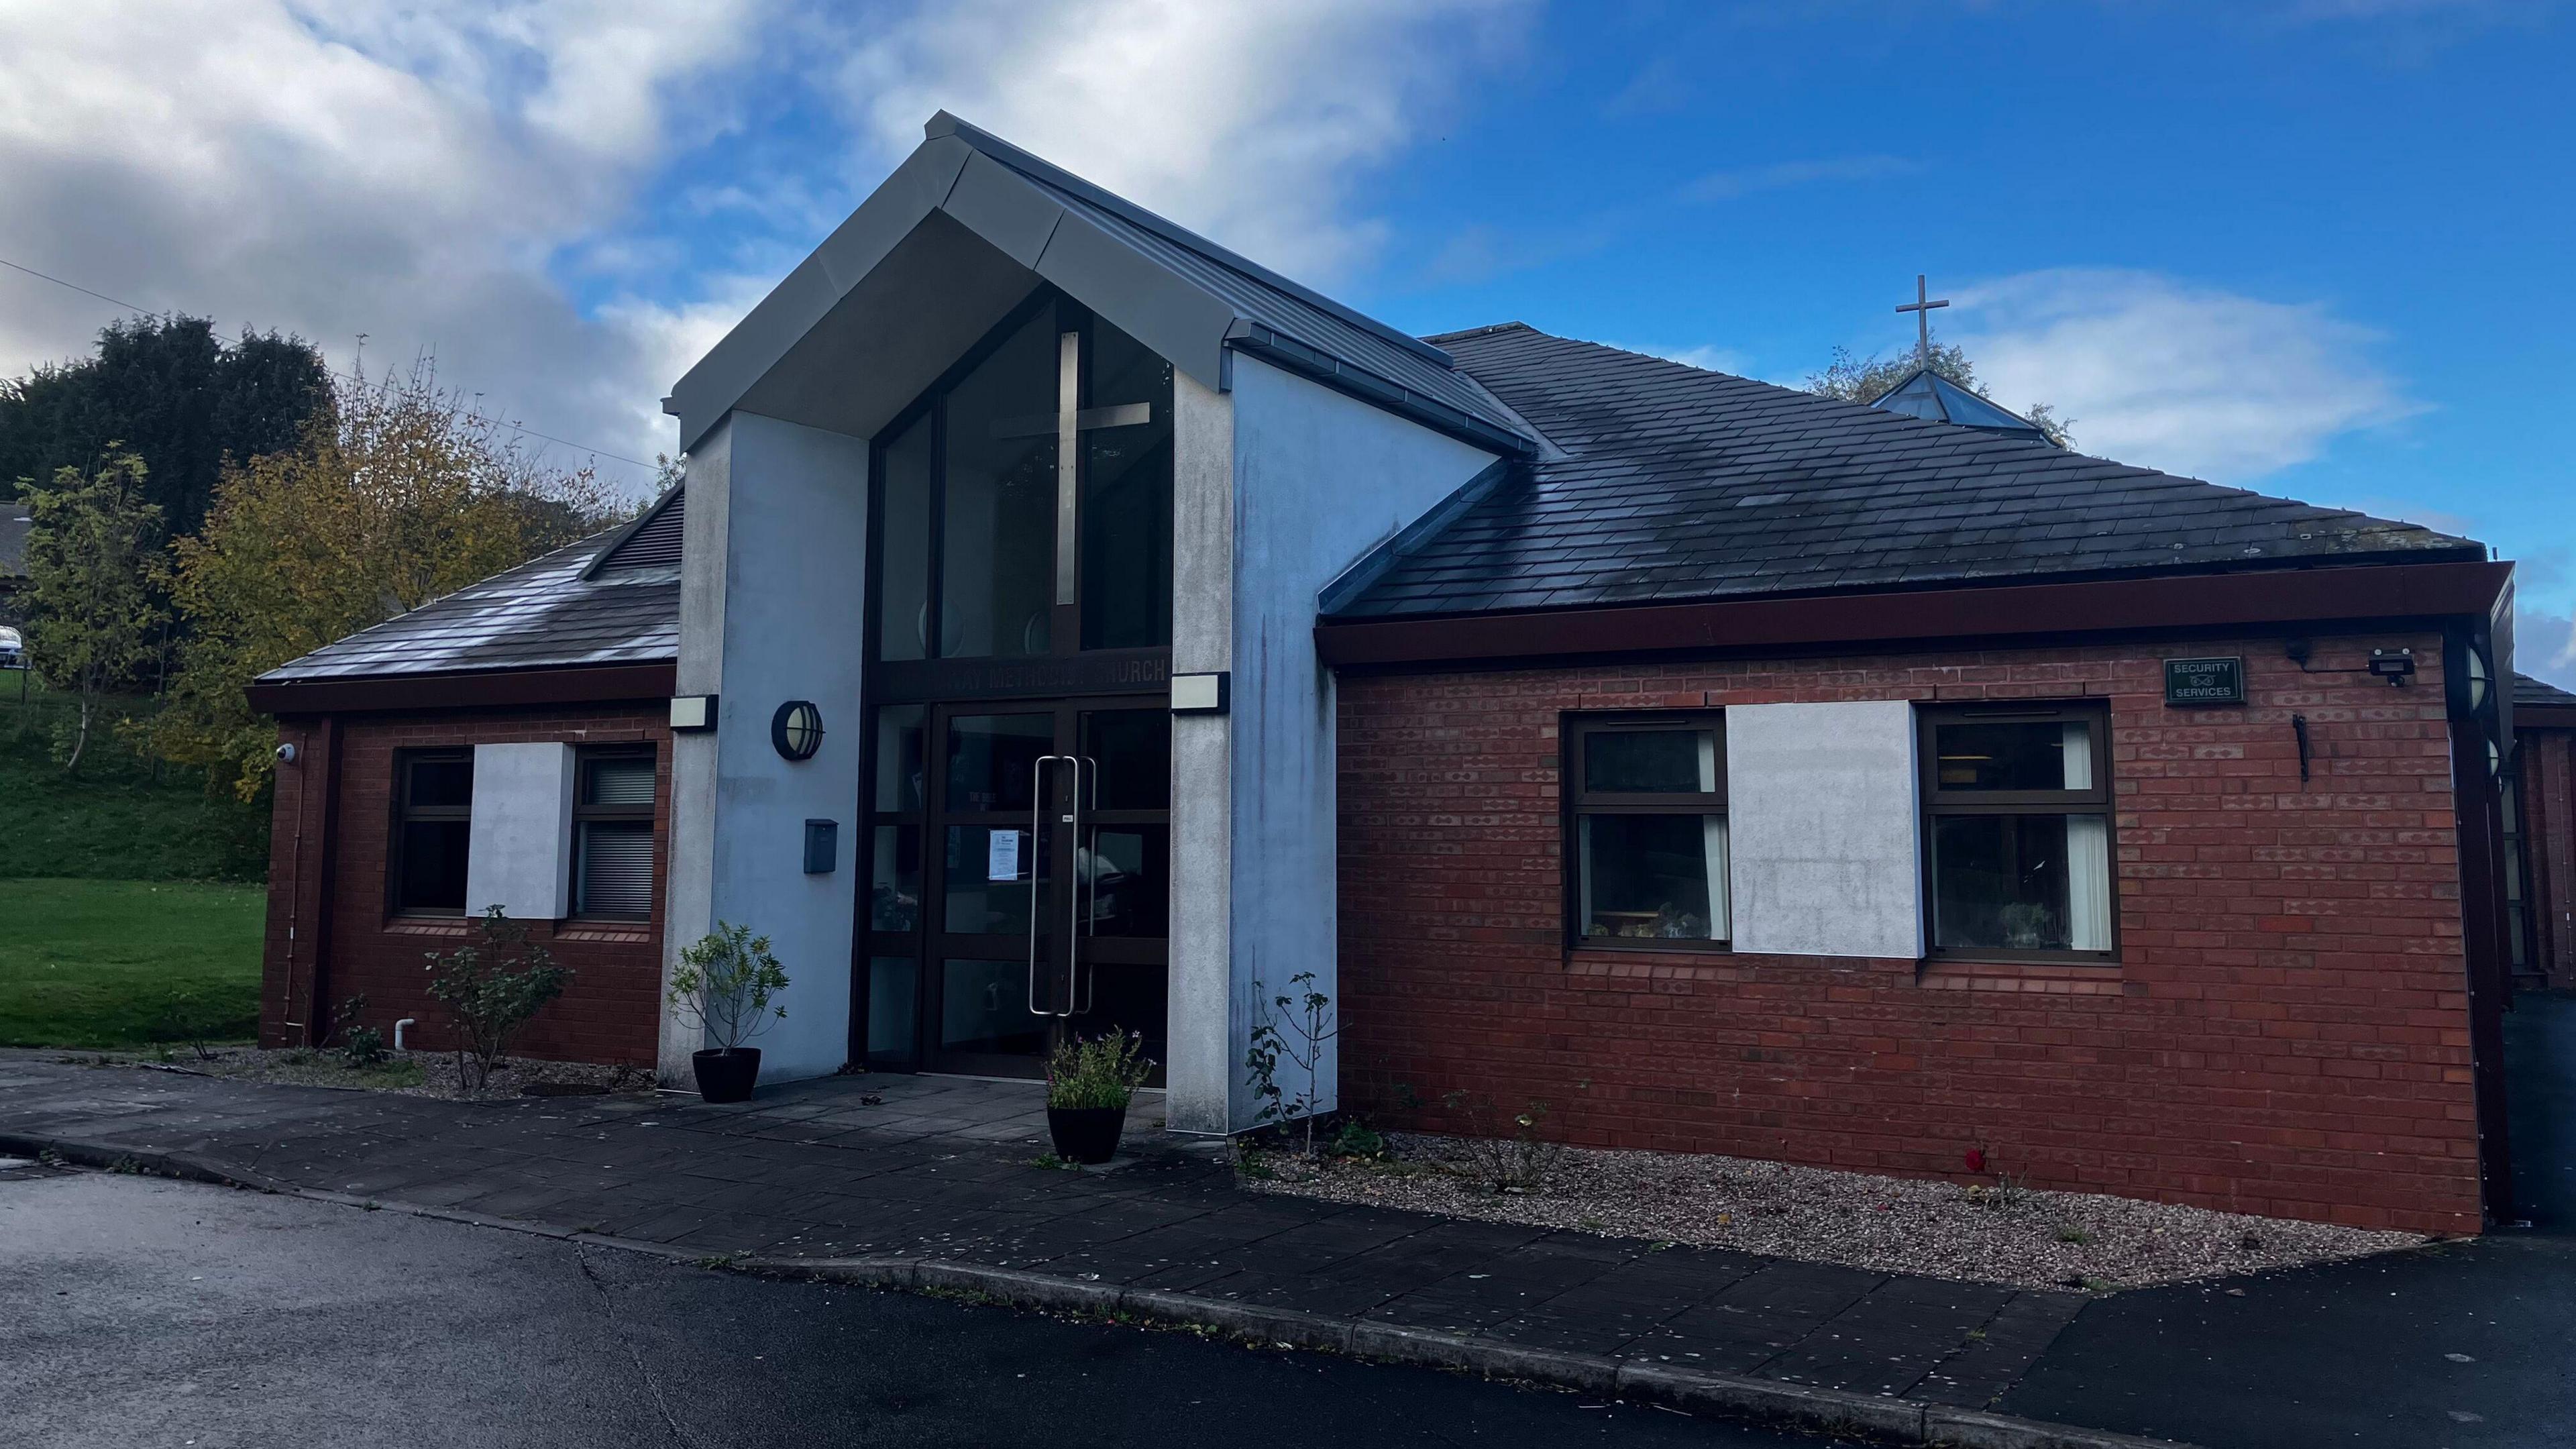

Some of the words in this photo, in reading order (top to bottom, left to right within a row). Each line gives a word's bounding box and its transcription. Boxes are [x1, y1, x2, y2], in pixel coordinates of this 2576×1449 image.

[1094, 659, 1166, 683] CHURCH
[2174, 663, 2230, 673] SECURITY
[2176, 686, 2231, 697] SERVICES
